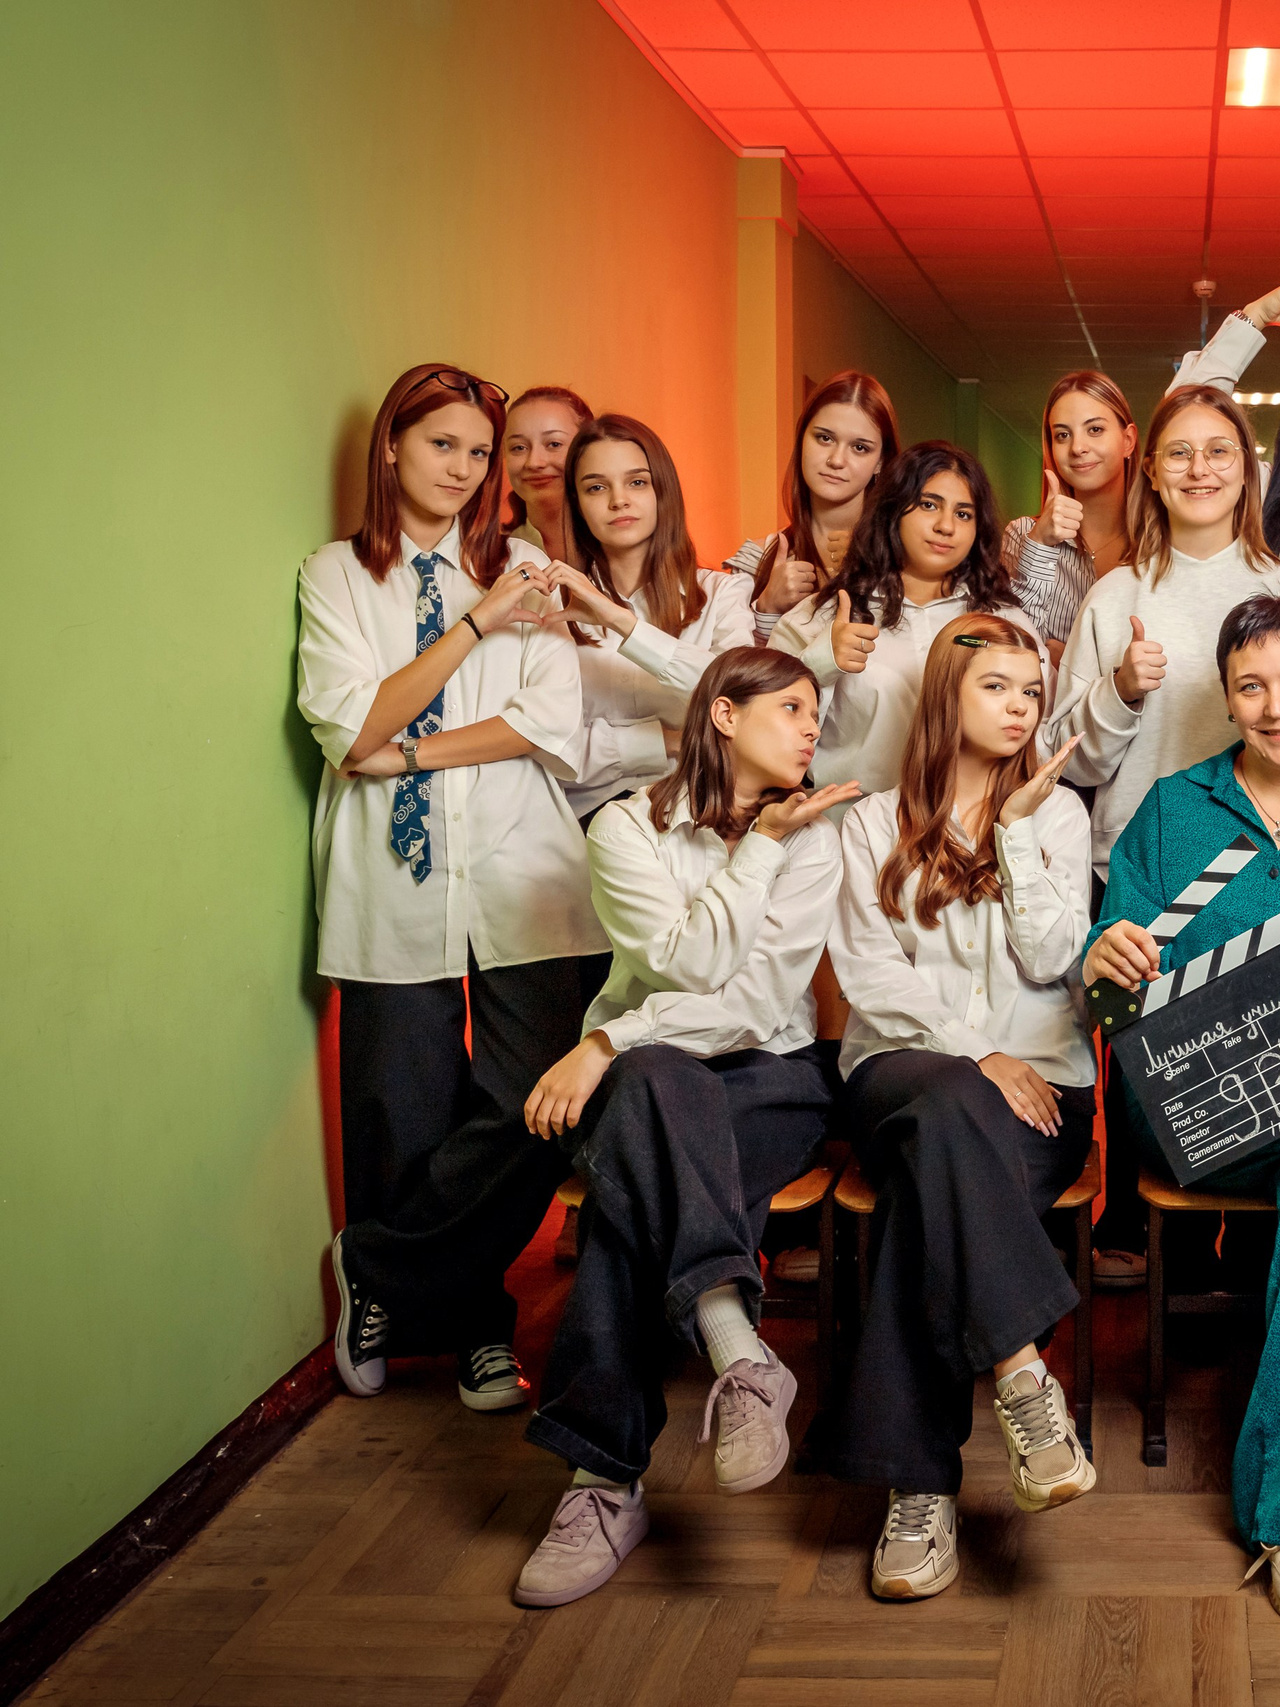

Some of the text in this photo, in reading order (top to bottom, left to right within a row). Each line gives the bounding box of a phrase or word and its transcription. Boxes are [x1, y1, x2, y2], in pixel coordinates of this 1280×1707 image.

[1222, 1035, 1242, 1050] Take
[1165, 1062, 1190, 1079] Scene
[1164, 1101, 1184, 1116] Date
[1172, 1109, 1209, 1132] Prod. Co.
[1179, 1126, 1211, 1147] Director
[1187, 1134, 1236, 1162] Cameraman
